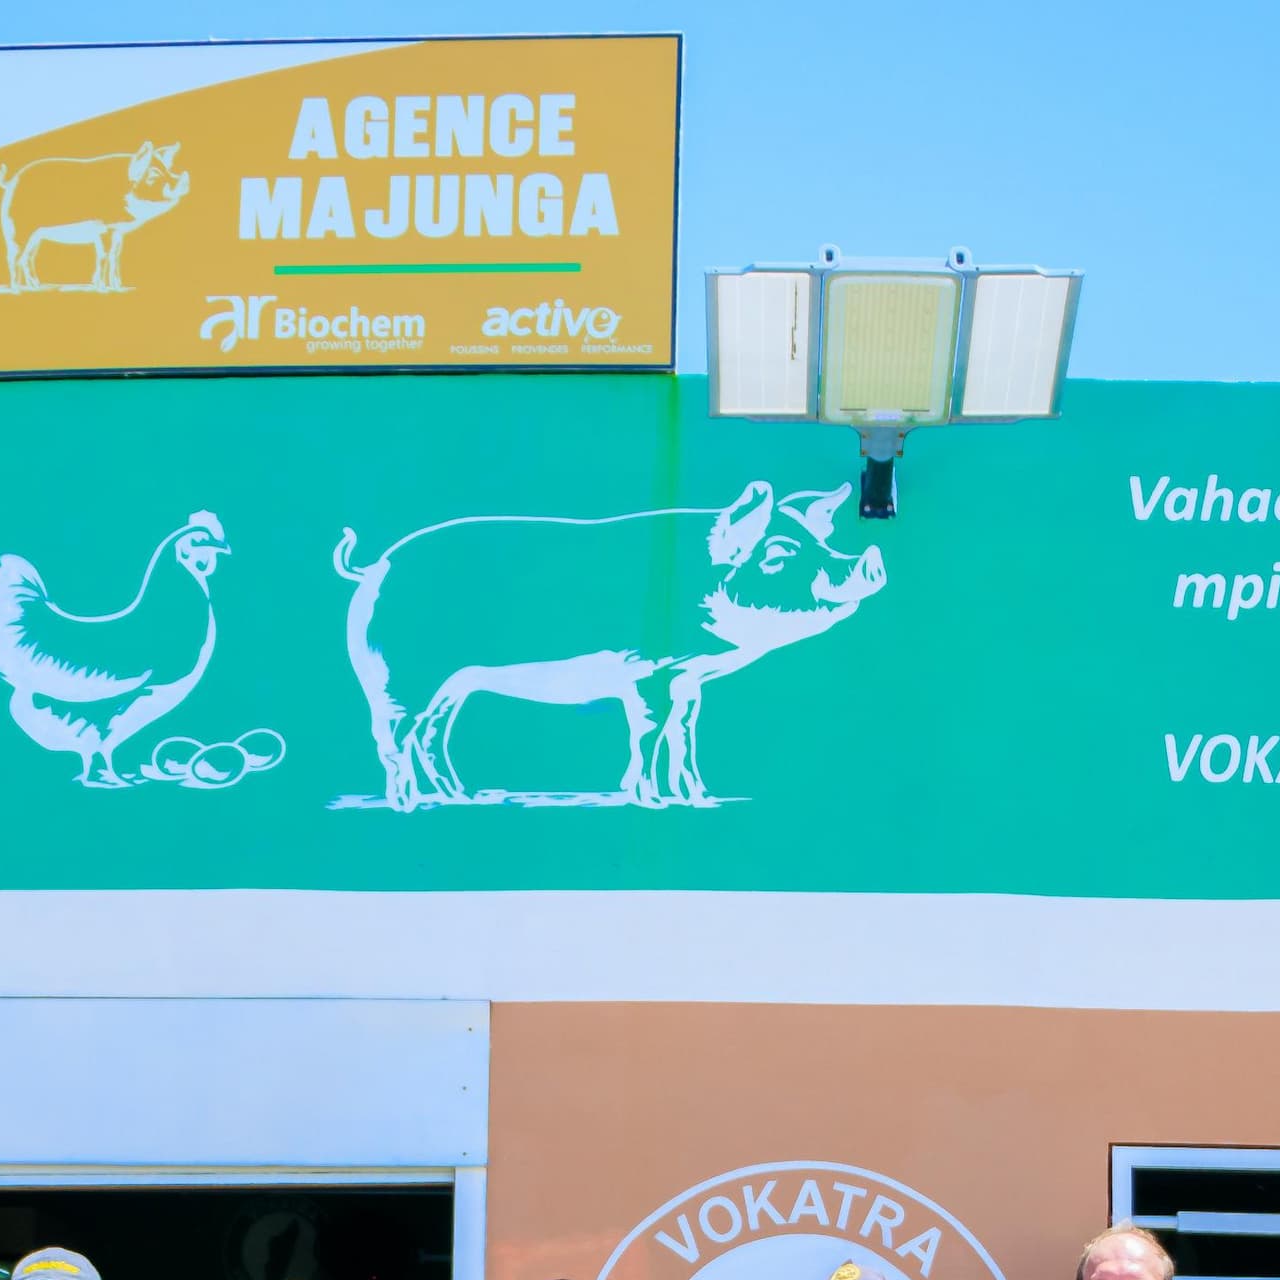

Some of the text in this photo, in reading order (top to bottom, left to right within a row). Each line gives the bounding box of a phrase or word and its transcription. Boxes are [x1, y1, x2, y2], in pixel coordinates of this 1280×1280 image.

[287, 93, 576, 159] AGENCE
[239, 172, 620, 240] MAJUNGA
[274, 305, 425, 339] Biochem
[306, 338, 424, 353] growing together
[655, 1179, 944, 1280] VOKATRA
